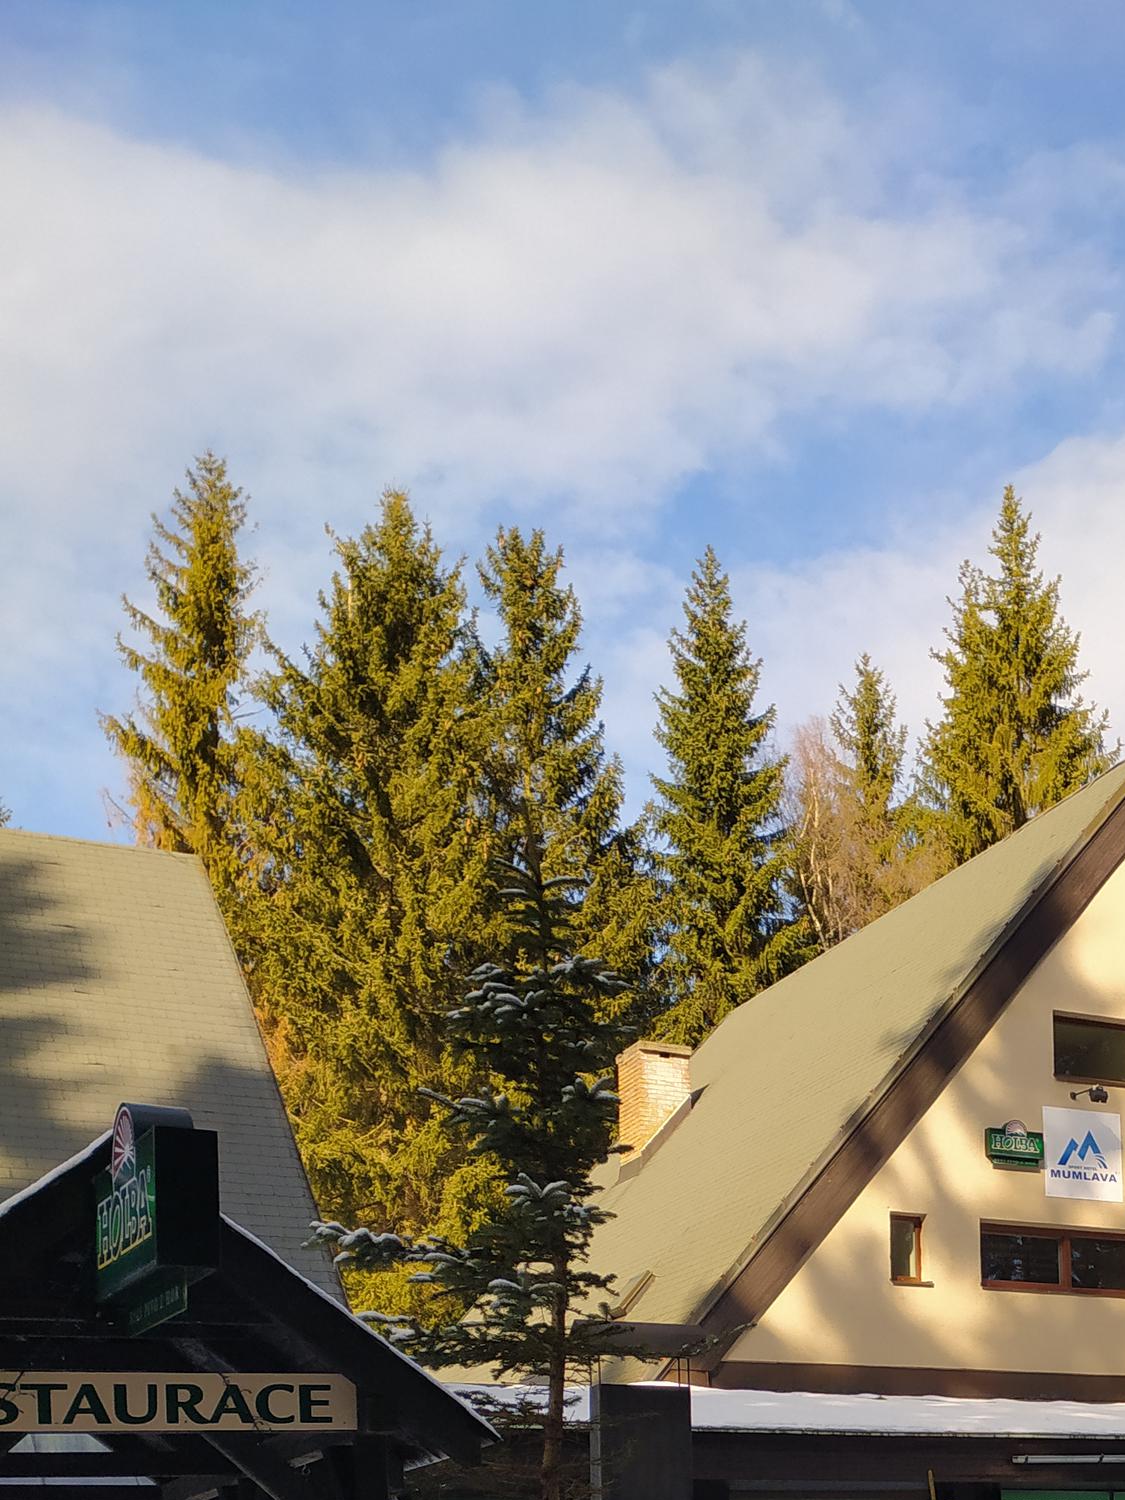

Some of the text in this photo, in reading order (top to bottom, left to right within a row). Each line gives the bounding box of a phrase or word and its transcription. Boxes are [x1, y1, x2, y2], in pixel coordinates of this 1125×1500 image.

[991, 1133, 1040, 1153] HOLBA
[1050, 1169, 1117, 1183] MUMLAVA
[97, 1168, 153, 1270] HOLBA
